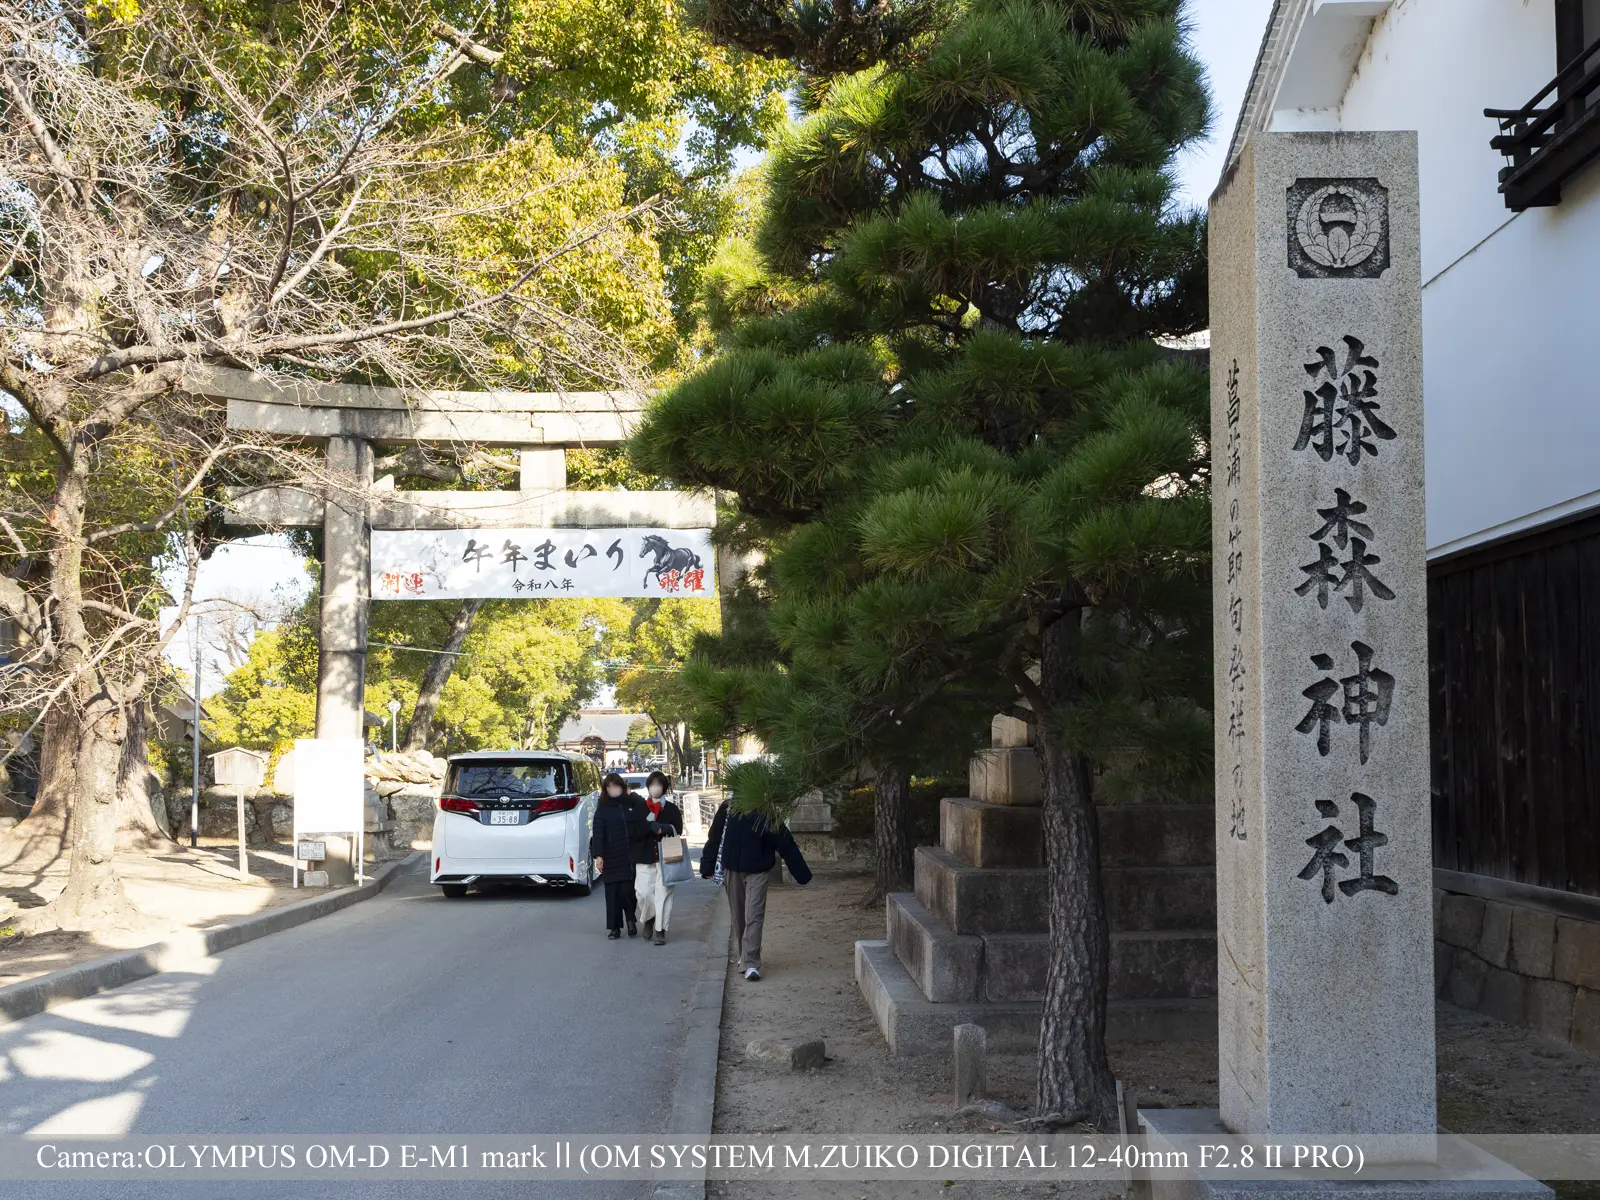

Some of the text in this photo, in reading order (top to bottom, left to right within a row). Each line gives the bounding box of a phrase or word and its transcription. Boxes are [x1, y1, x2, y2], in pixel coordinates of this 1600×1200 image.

[462, 538, 625, 573] 午年まいり
[380, 571, 426, 595] 開運
[511, 578, 575, 593] 令和八年
[1292, 334, 1399, 904] 藤森神社
